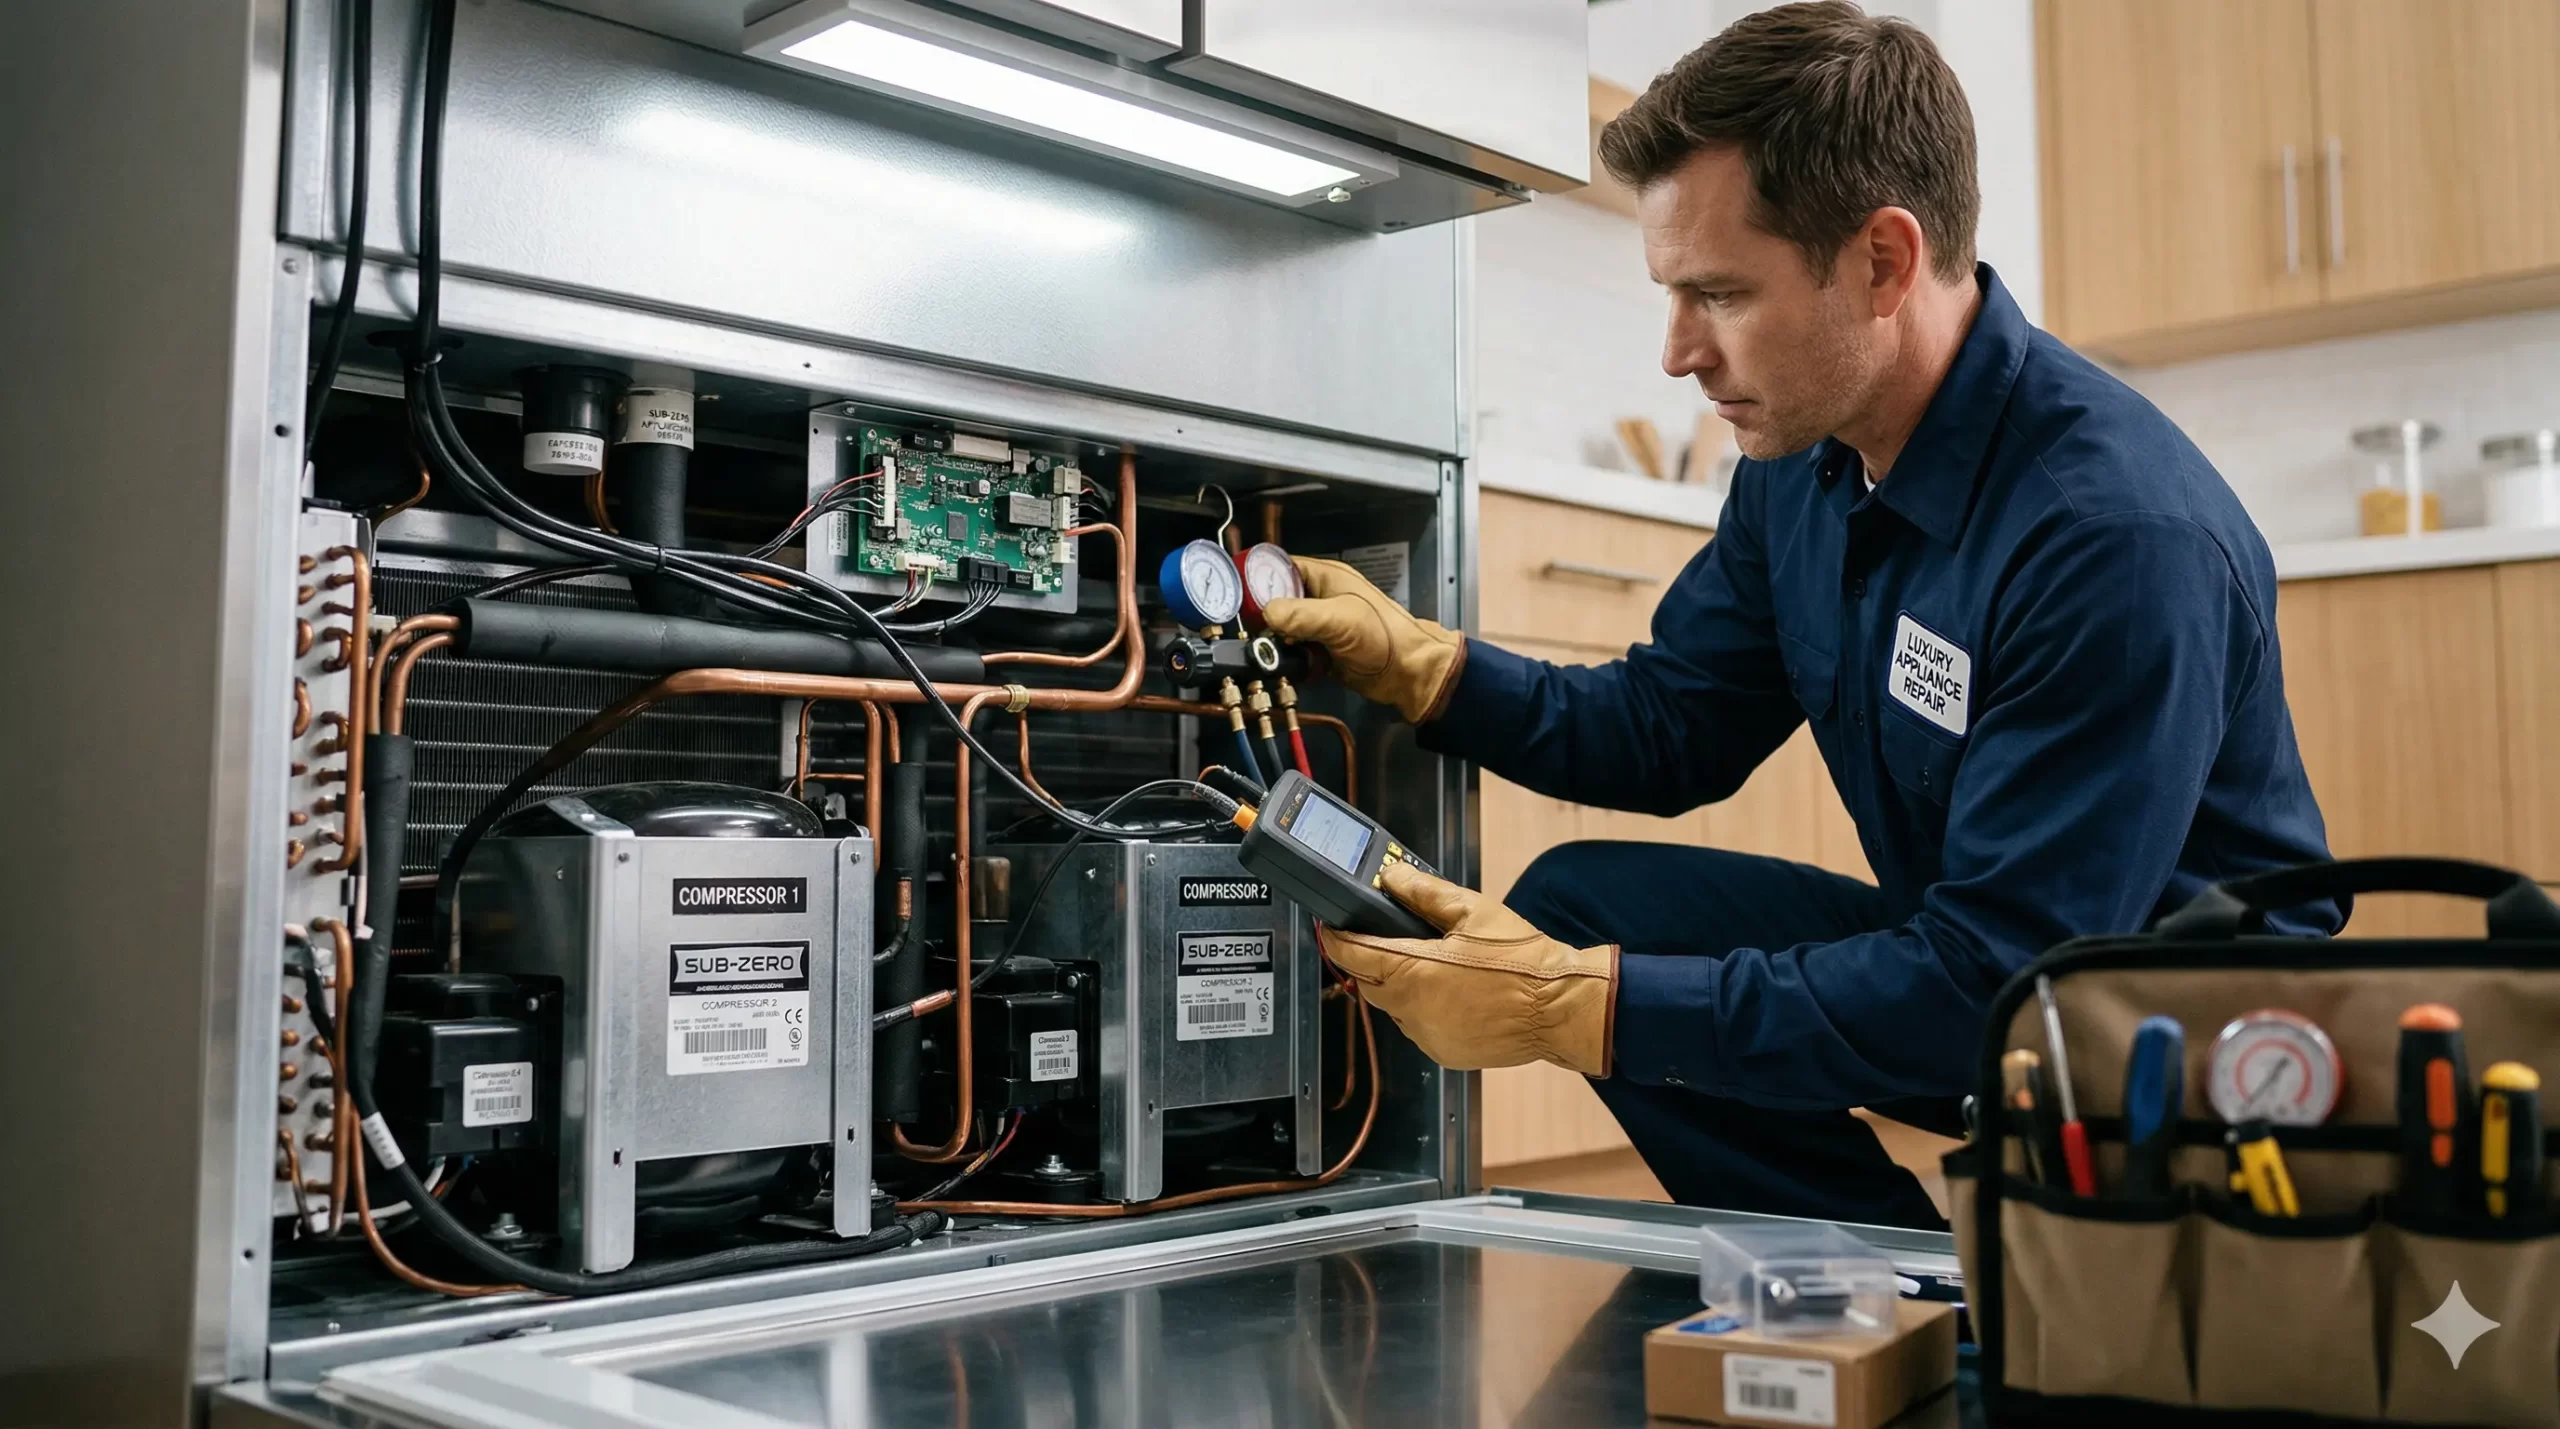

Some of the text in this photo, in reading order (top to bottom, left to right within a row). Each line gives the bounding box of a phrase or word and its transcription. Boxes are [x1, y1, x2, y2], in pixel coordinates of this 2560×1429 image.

[1907, 632, 1953, 673] LUXURY
[1895, 649, 1962, 702] APPLIANCE
[1903, 676, 1946, 715] REPAIR
[679, 886, 798, 906] COMPRESSOR 1
[1183, 883, 1268, 900] COMPRESSOR 2
[1188, 943, 1263, 958] SUB-ZERO
[685, 955, 794, 974] SUB-ZERO
[702, 998, 778, 1011] COMPRESSOR 2
